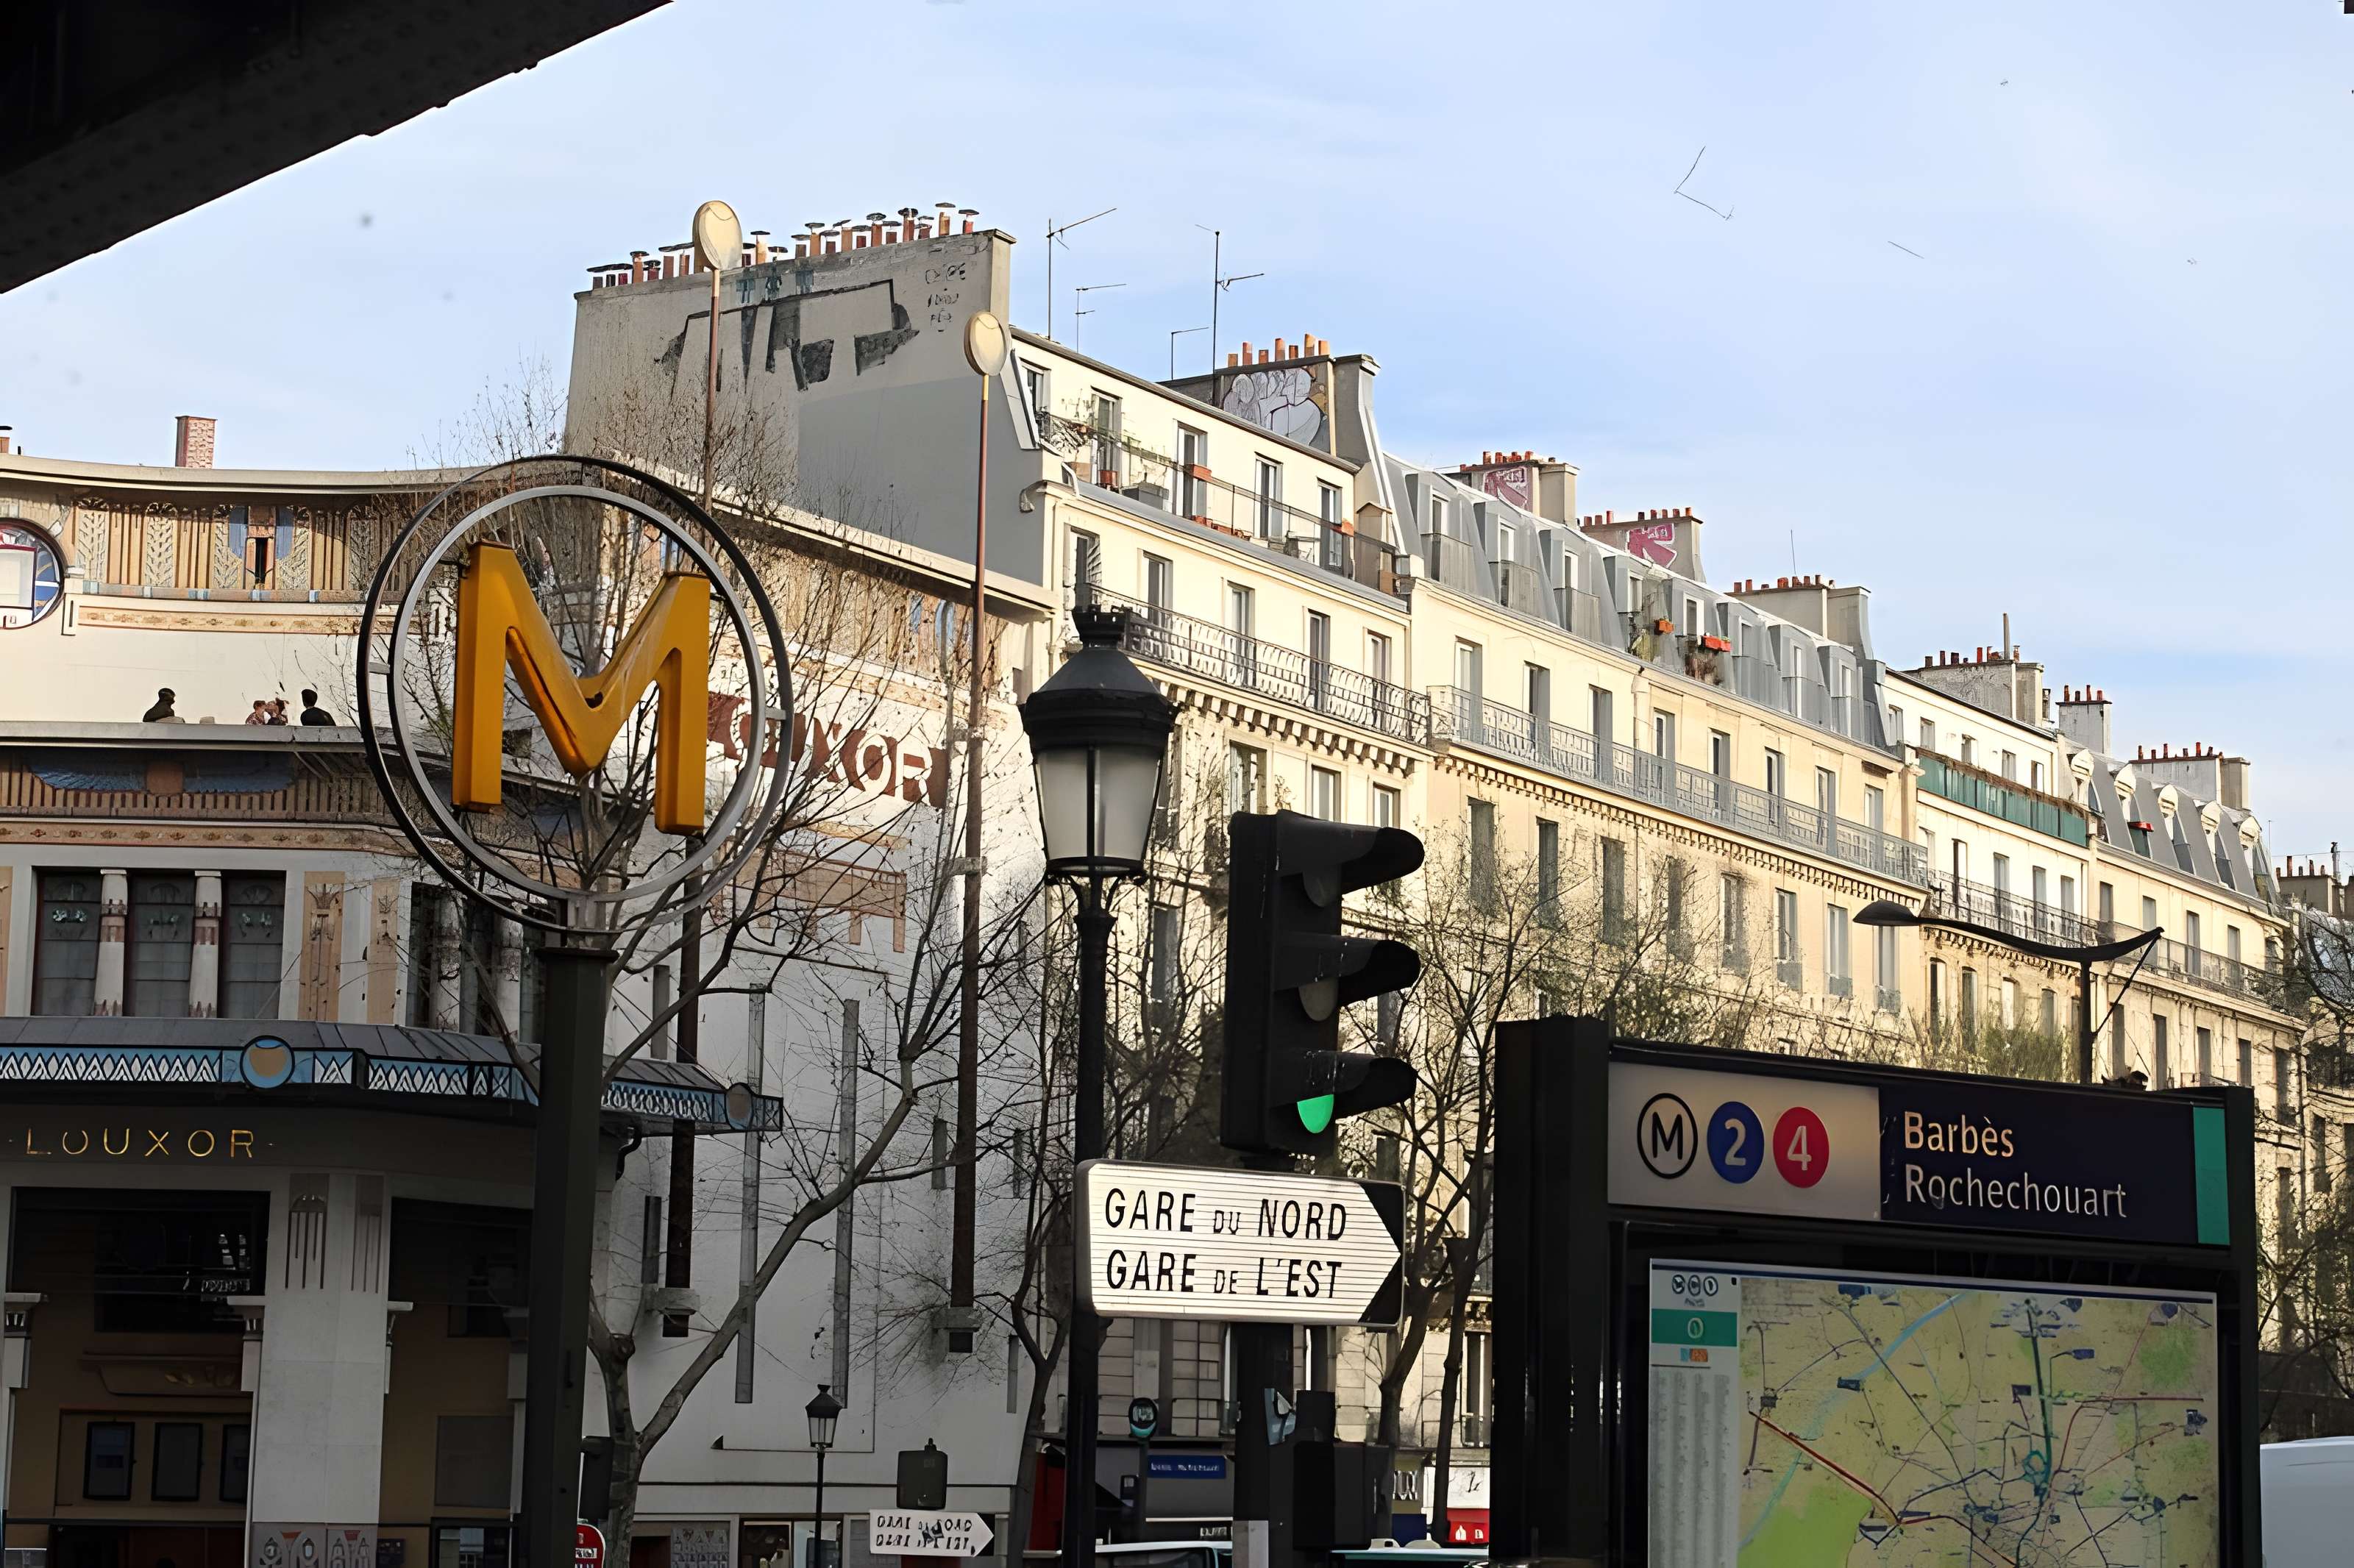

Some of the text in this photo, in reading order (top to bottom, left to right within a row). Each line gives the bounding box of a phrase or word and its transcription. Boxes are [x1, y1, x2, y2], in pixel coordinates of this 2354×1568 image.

[452, 539, 712, 837] M
[26, 1127, 255, 1159] LOUXOR
[1724, 1118, 1746, 1166] 2
[1787, 1125, 1812, 1171] 4
[1904, 1111, 2014, 1158] Barbès
[1105, 1188, 1347, 1241] GARE DU NORD
[1905, 1163, 2127, 1218] Rochechouart
[1106, 1249, 1343, 1299] GARE DE L'EST
